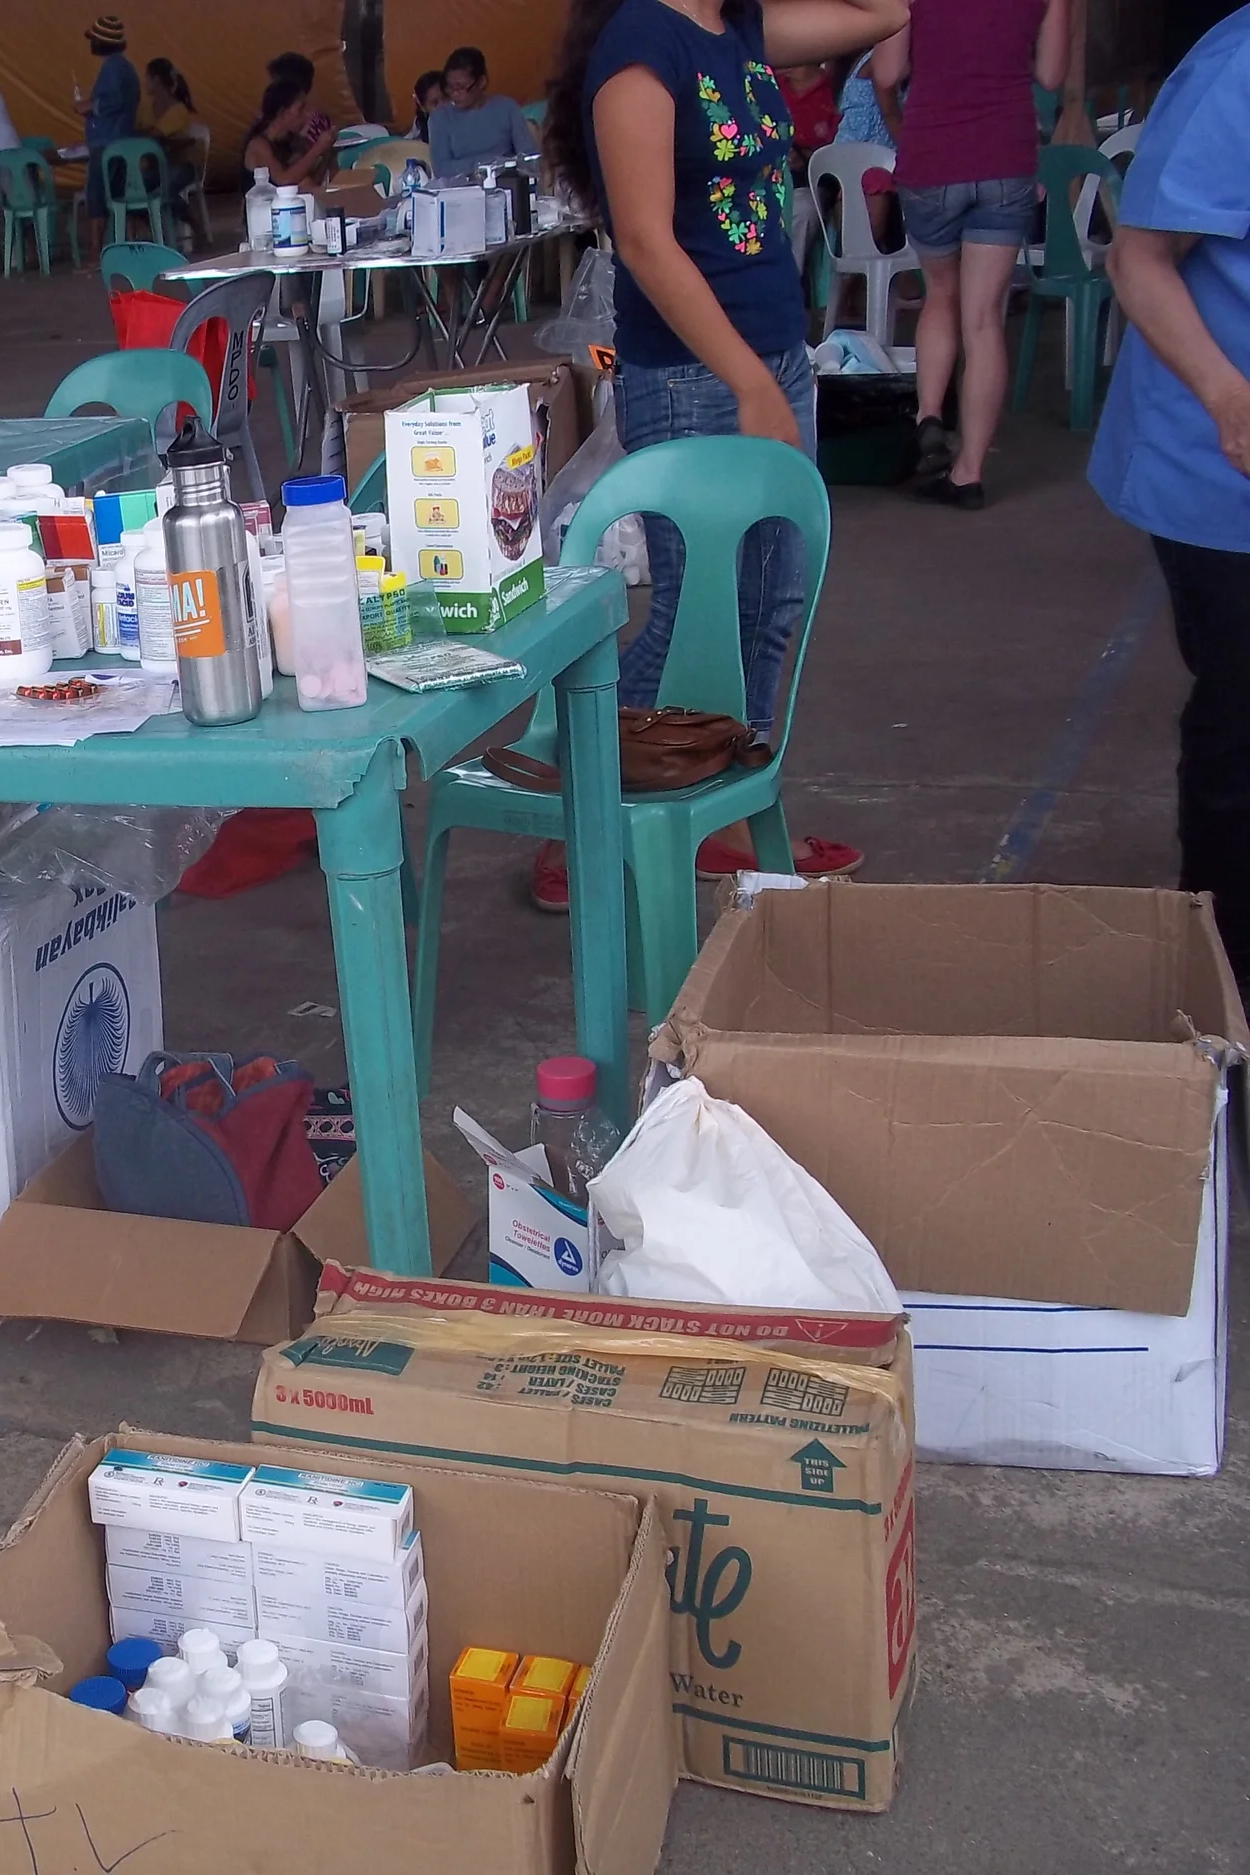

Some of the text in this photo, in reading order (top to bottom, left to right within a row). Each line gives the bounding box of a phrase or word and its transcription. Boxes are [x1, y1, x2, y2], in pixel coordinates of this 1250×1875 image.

[501, 577, 529, 606] Sandwich
[512, 1219, 551, 1242] Obstetrical
[513, 1229, 551, 1252] Towelettes
[353, 1281, 789, 1337] DO NOT STACK MORE THAN 3 BOXES HIGH
[559, 1365, 622, 1386] STACKING
[582, 1357, 626, 1375] PALLET
[528, 1376, 566, 1387] LAYER
[575, 1383, 617, 1397] CASES
[275, 1384, 374, 1416] 3 x 5000mL
[570, 1393, 613, 1408] CASES
[729, 1412, 870, 1435] PALLETIZING PATTERN
[803, 1457, 830, 1468] THIS
[804, 1467, 830, 1477] SIDE
[300, 1472, 347, 1485] RANITIDINE
[809, 1477, 826, 1486] UP
[669, 1671, 744, 1708] Water
